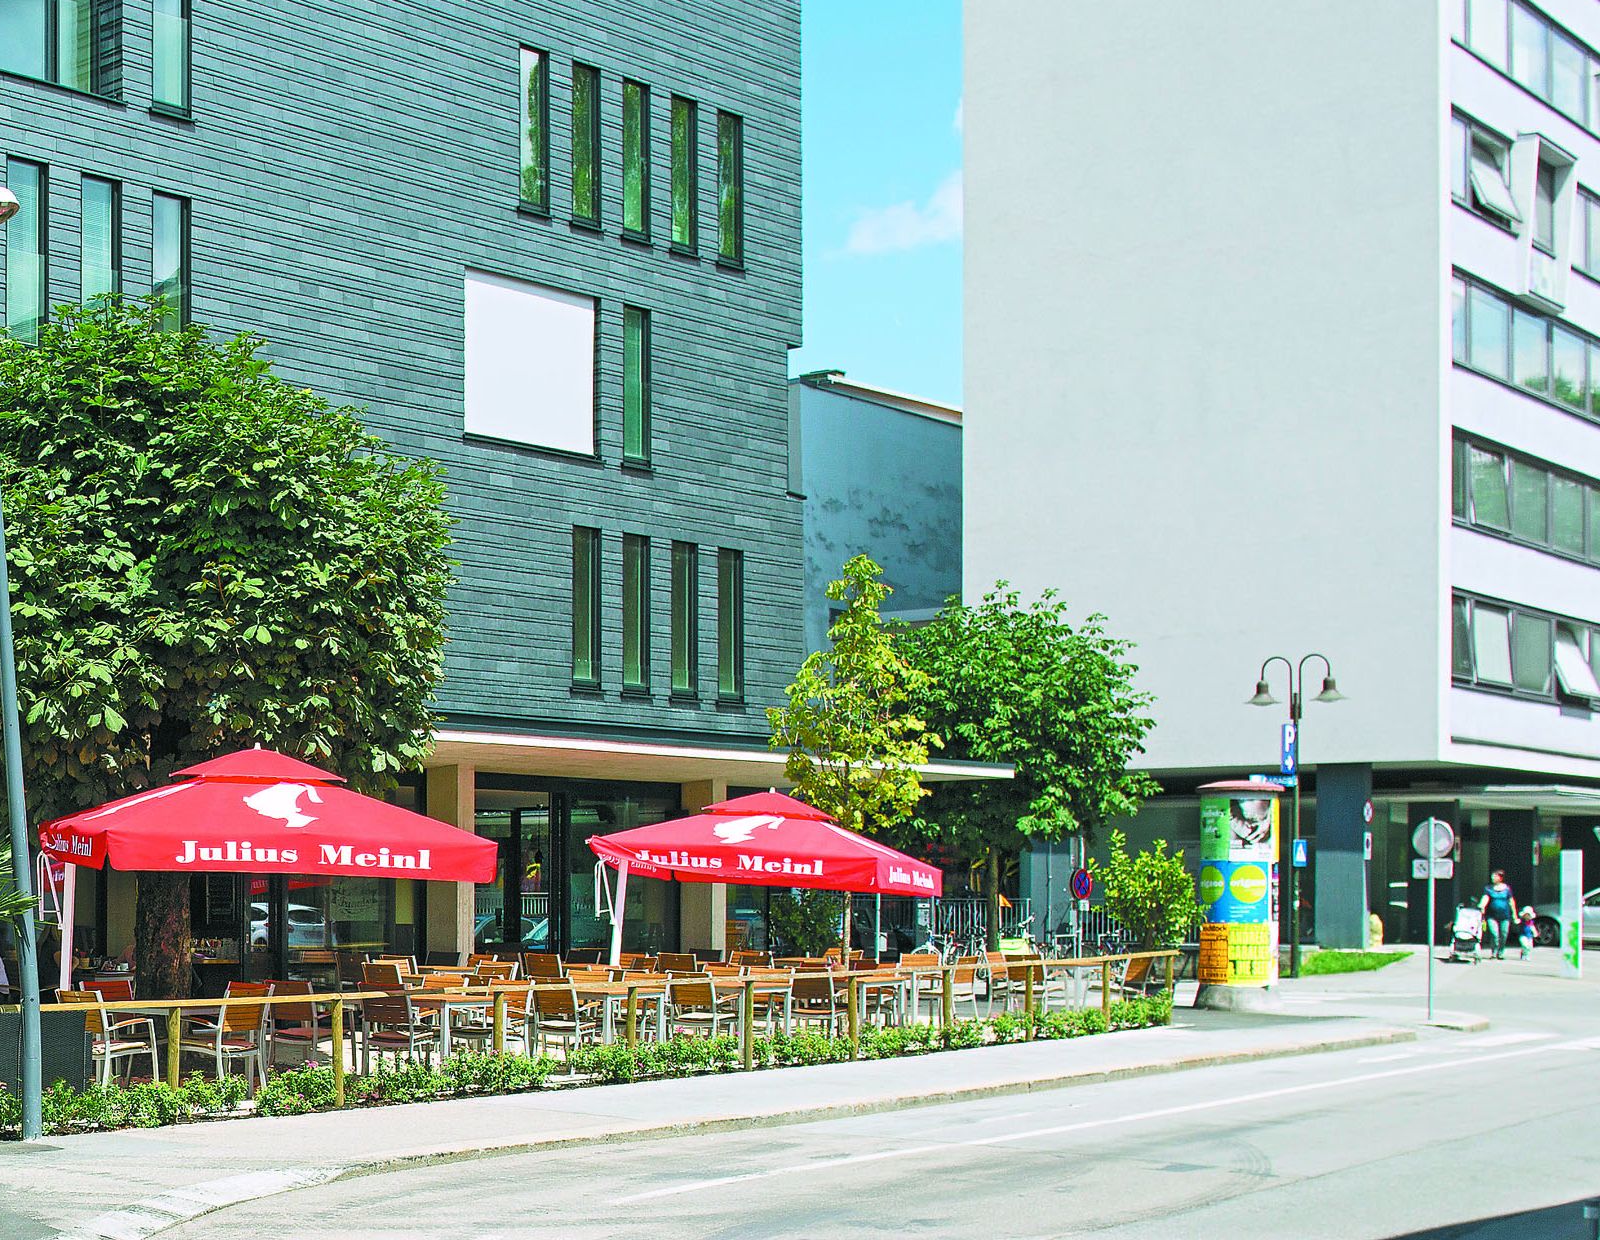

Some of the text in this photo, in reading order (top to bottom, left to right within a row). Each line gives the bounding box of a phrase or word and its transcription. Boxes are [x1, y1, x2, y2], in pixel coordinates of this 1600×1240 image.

[1284, 724, 1295, 752] P
[70, 835, 92, 857] Meinl
[176, 840, 432, 870] Julius Meinl
[635, 850, 723, 869] Julius
[736, 854, 824, 876] Meinl
